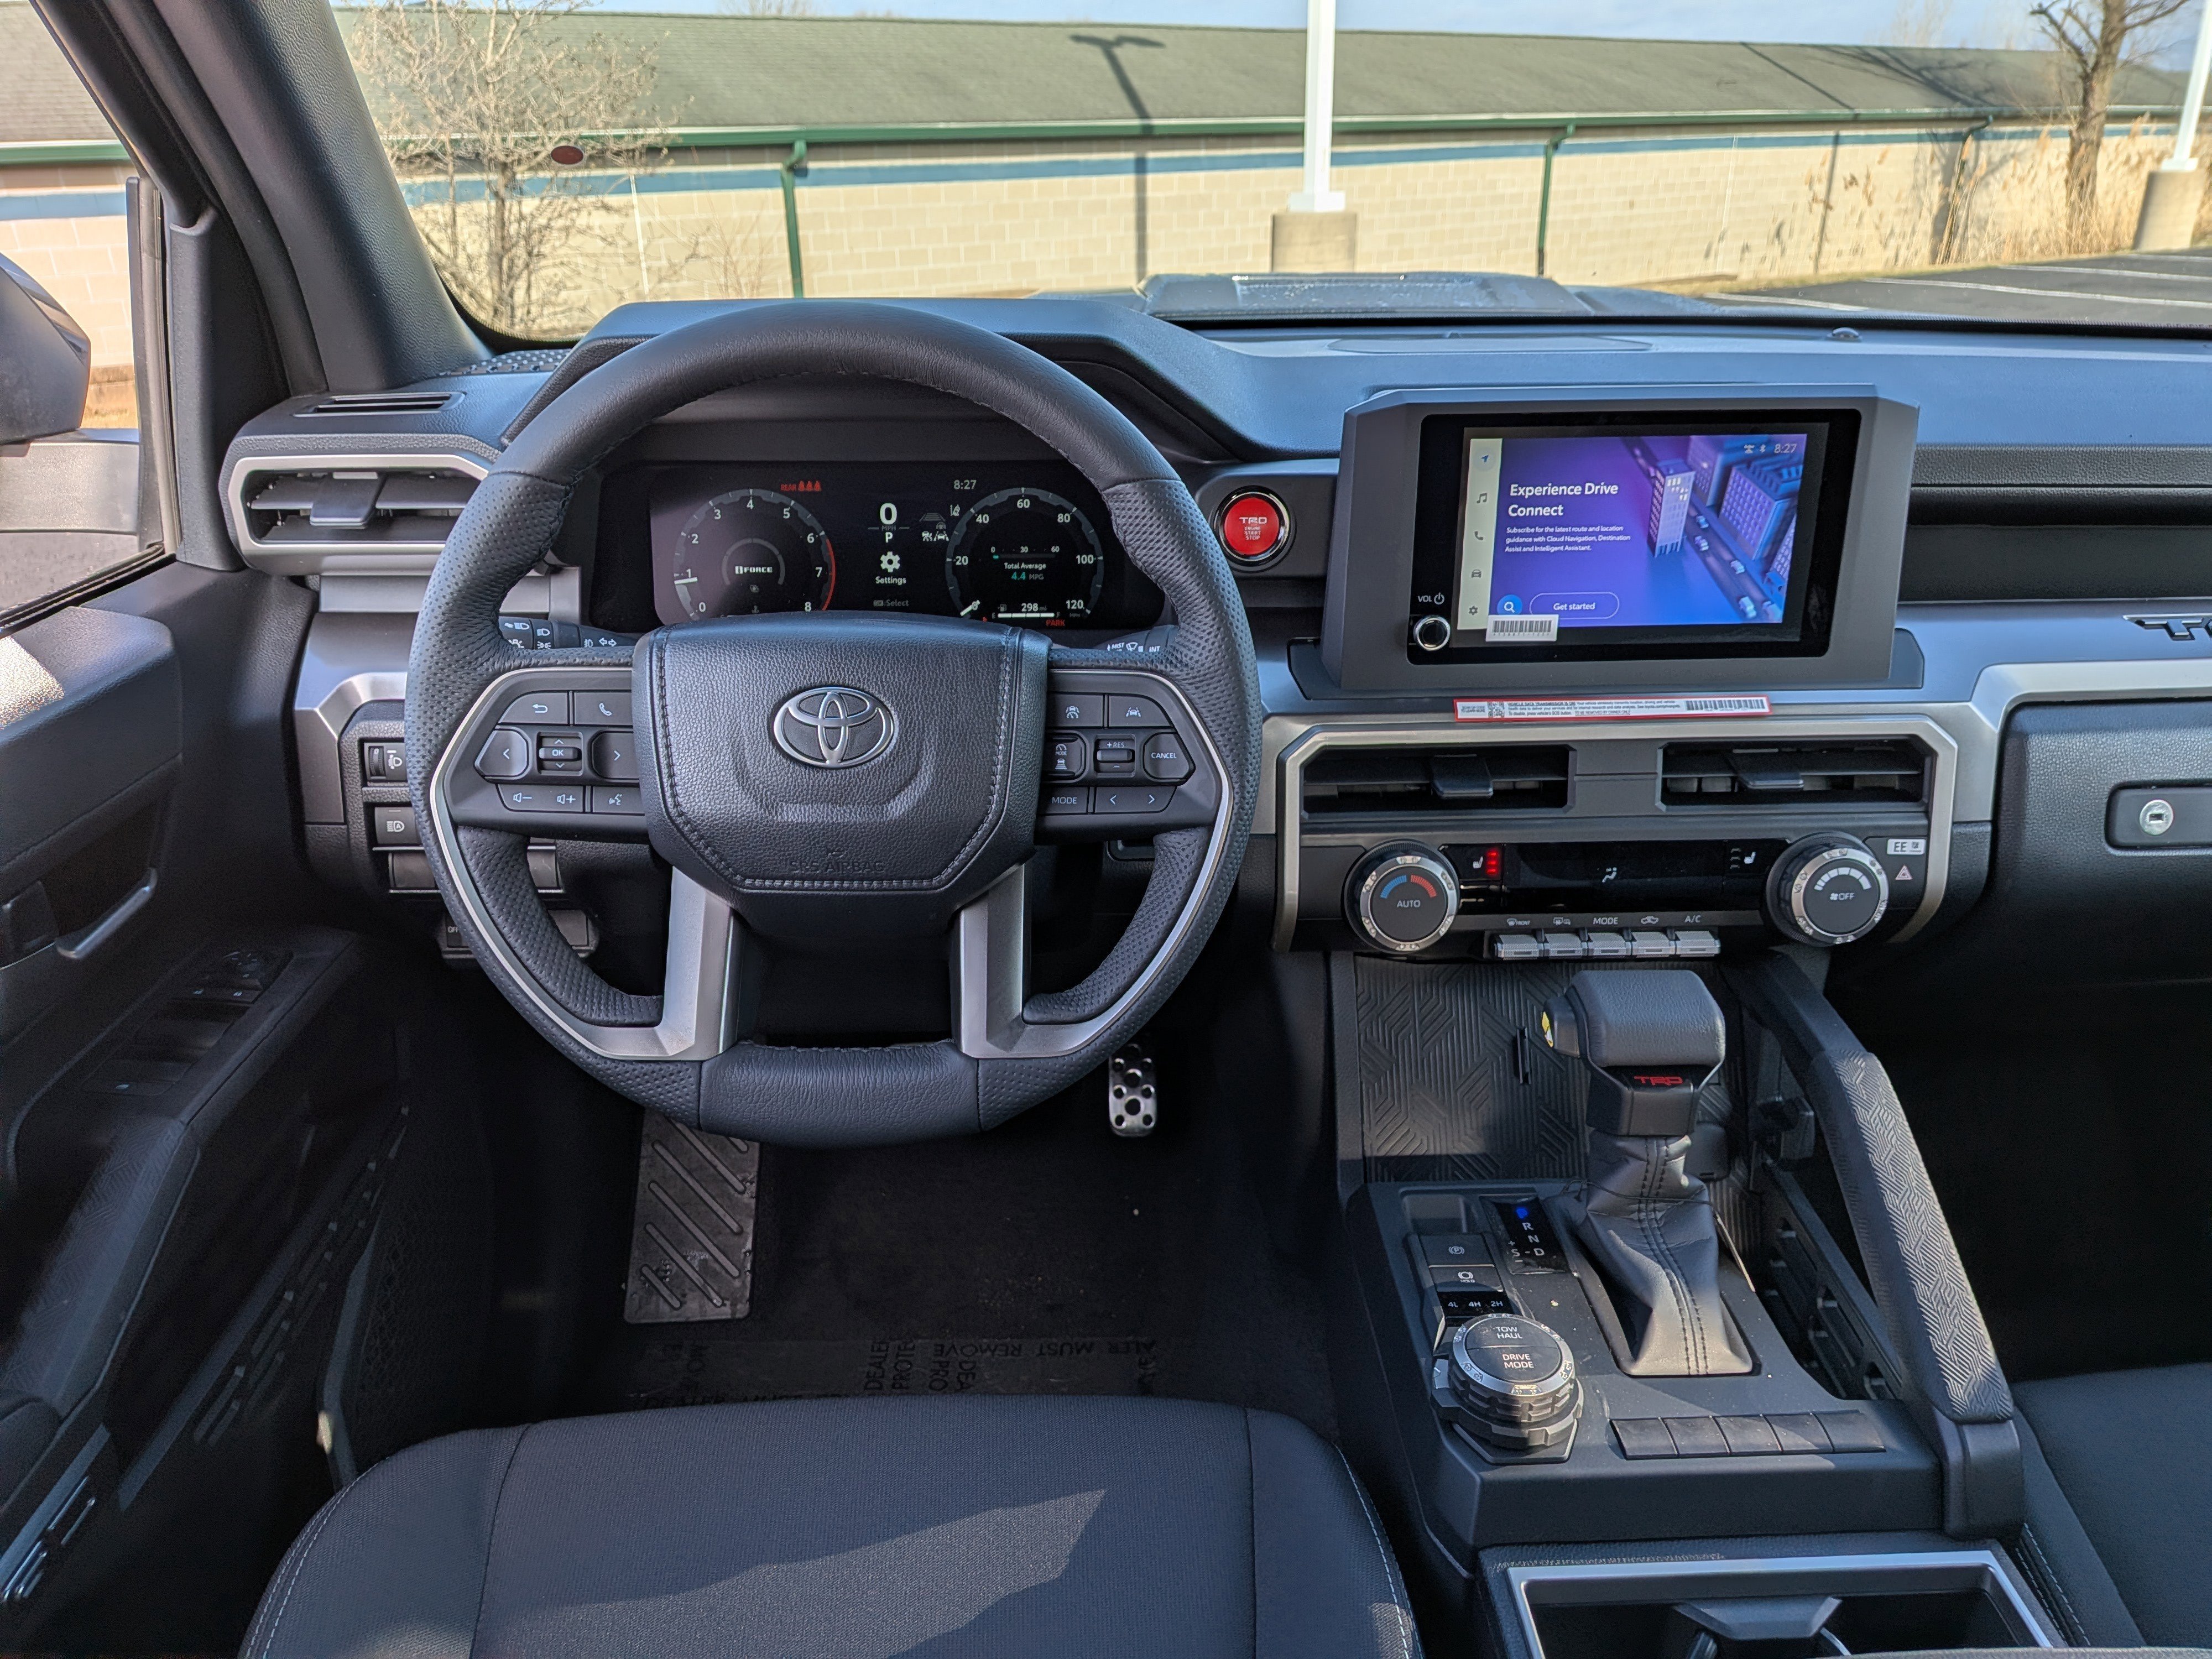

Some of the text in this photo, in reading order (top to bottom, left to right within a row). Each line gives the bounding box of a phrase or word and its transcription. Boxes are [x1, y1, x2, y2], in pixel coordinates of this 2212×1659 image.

[1773, 443, 1797, 453] 8:27
[953, 479, 977, 490] 8:27
[1510, 482, 1619, 498] Experience Drive
[747, 499, 754, 509] 4
[1016, 499, 1030, 508] 60
[714, 509, 721, 520] 3
[782, 508, 790, 519] 5
[879, 502, 898, 525] 0
[1508, 504, 1564, 517] Connect
[975, 514, 989, 524] 40
[1057, 513, 1071, 523] 80
[1239, 517, 1267, 525] TRD
[691, 534, 699, 544] 2
[807, 533, 815, 543] 6
[885, 531, 893, 543] P
[955, 556, 968, 565] 20
[1076, 555, 1094, 564] 100
[686, 568, 692, 578] 1
[815, 567, 823, 577] 7
[1011, 572, 1026, 580] 4.4
[875, 576, 906, 586] Settings
[698, 602, 706, 612] 0
[804, 601, 812, 612] 8
[1021, 602, 1038, 612] 298
[1066, 599, 1083, 609] 120
[1553, 601, 1596, 611] Get started
[552, 749, 564, 757] OK
[1051, 796, 1077, 805] MODE
[1893, 842, 1907, 852] EE
[789, 860, 885, 874] SRS AIRBAG
[1838, 892, 1855, 901] OFF
[1396, 899, 1421, 908] AUTO
[1593, 917, 1619, 925] MODE
[1684, 914, 1701, 923] A/C
[1634, 1076, 1683, 1086] TRD
[1522, 1222, 1534, 1231] R
[1527, 1234, 1540, 1244] N
[1511, 1249, 1520, 1257] S
[1533, 1248, 1545, 1256] D
